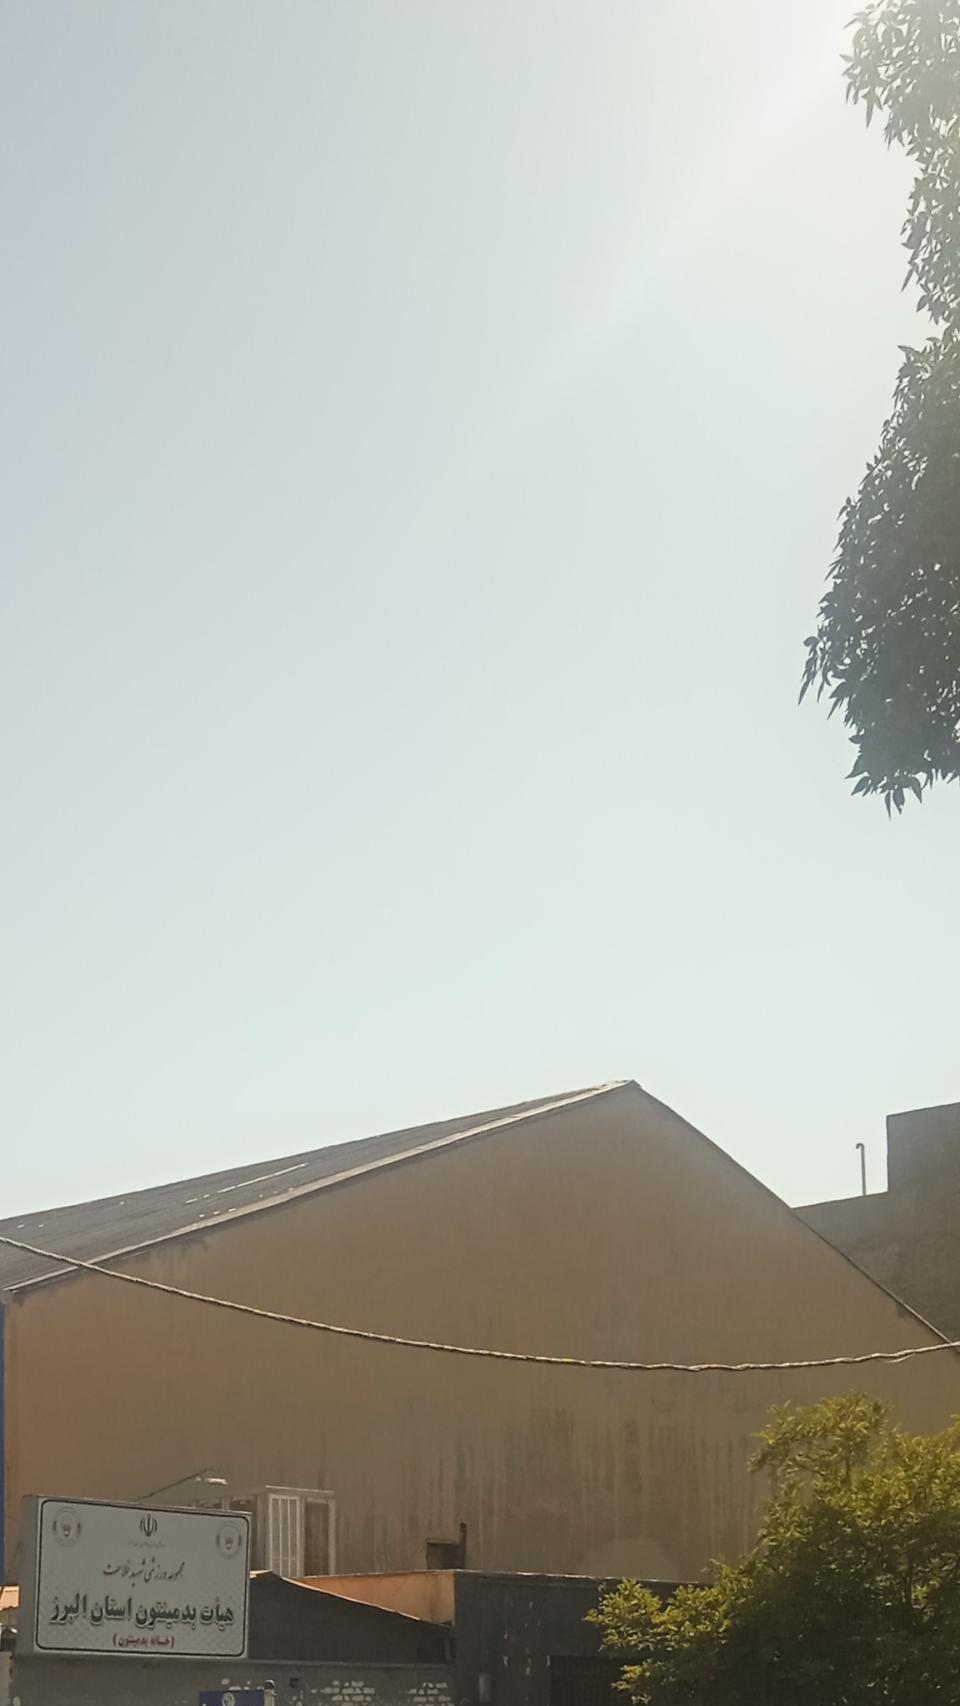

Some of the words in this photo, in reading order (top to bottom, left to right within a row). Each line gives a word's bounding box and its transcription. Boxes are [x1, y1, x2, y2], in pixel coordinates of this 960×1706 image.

[49, 1592, 88, 1623] البرز
[91, 1595, 132, 1624] استان
[135, 1602, 197, 1630] بدمینتون
